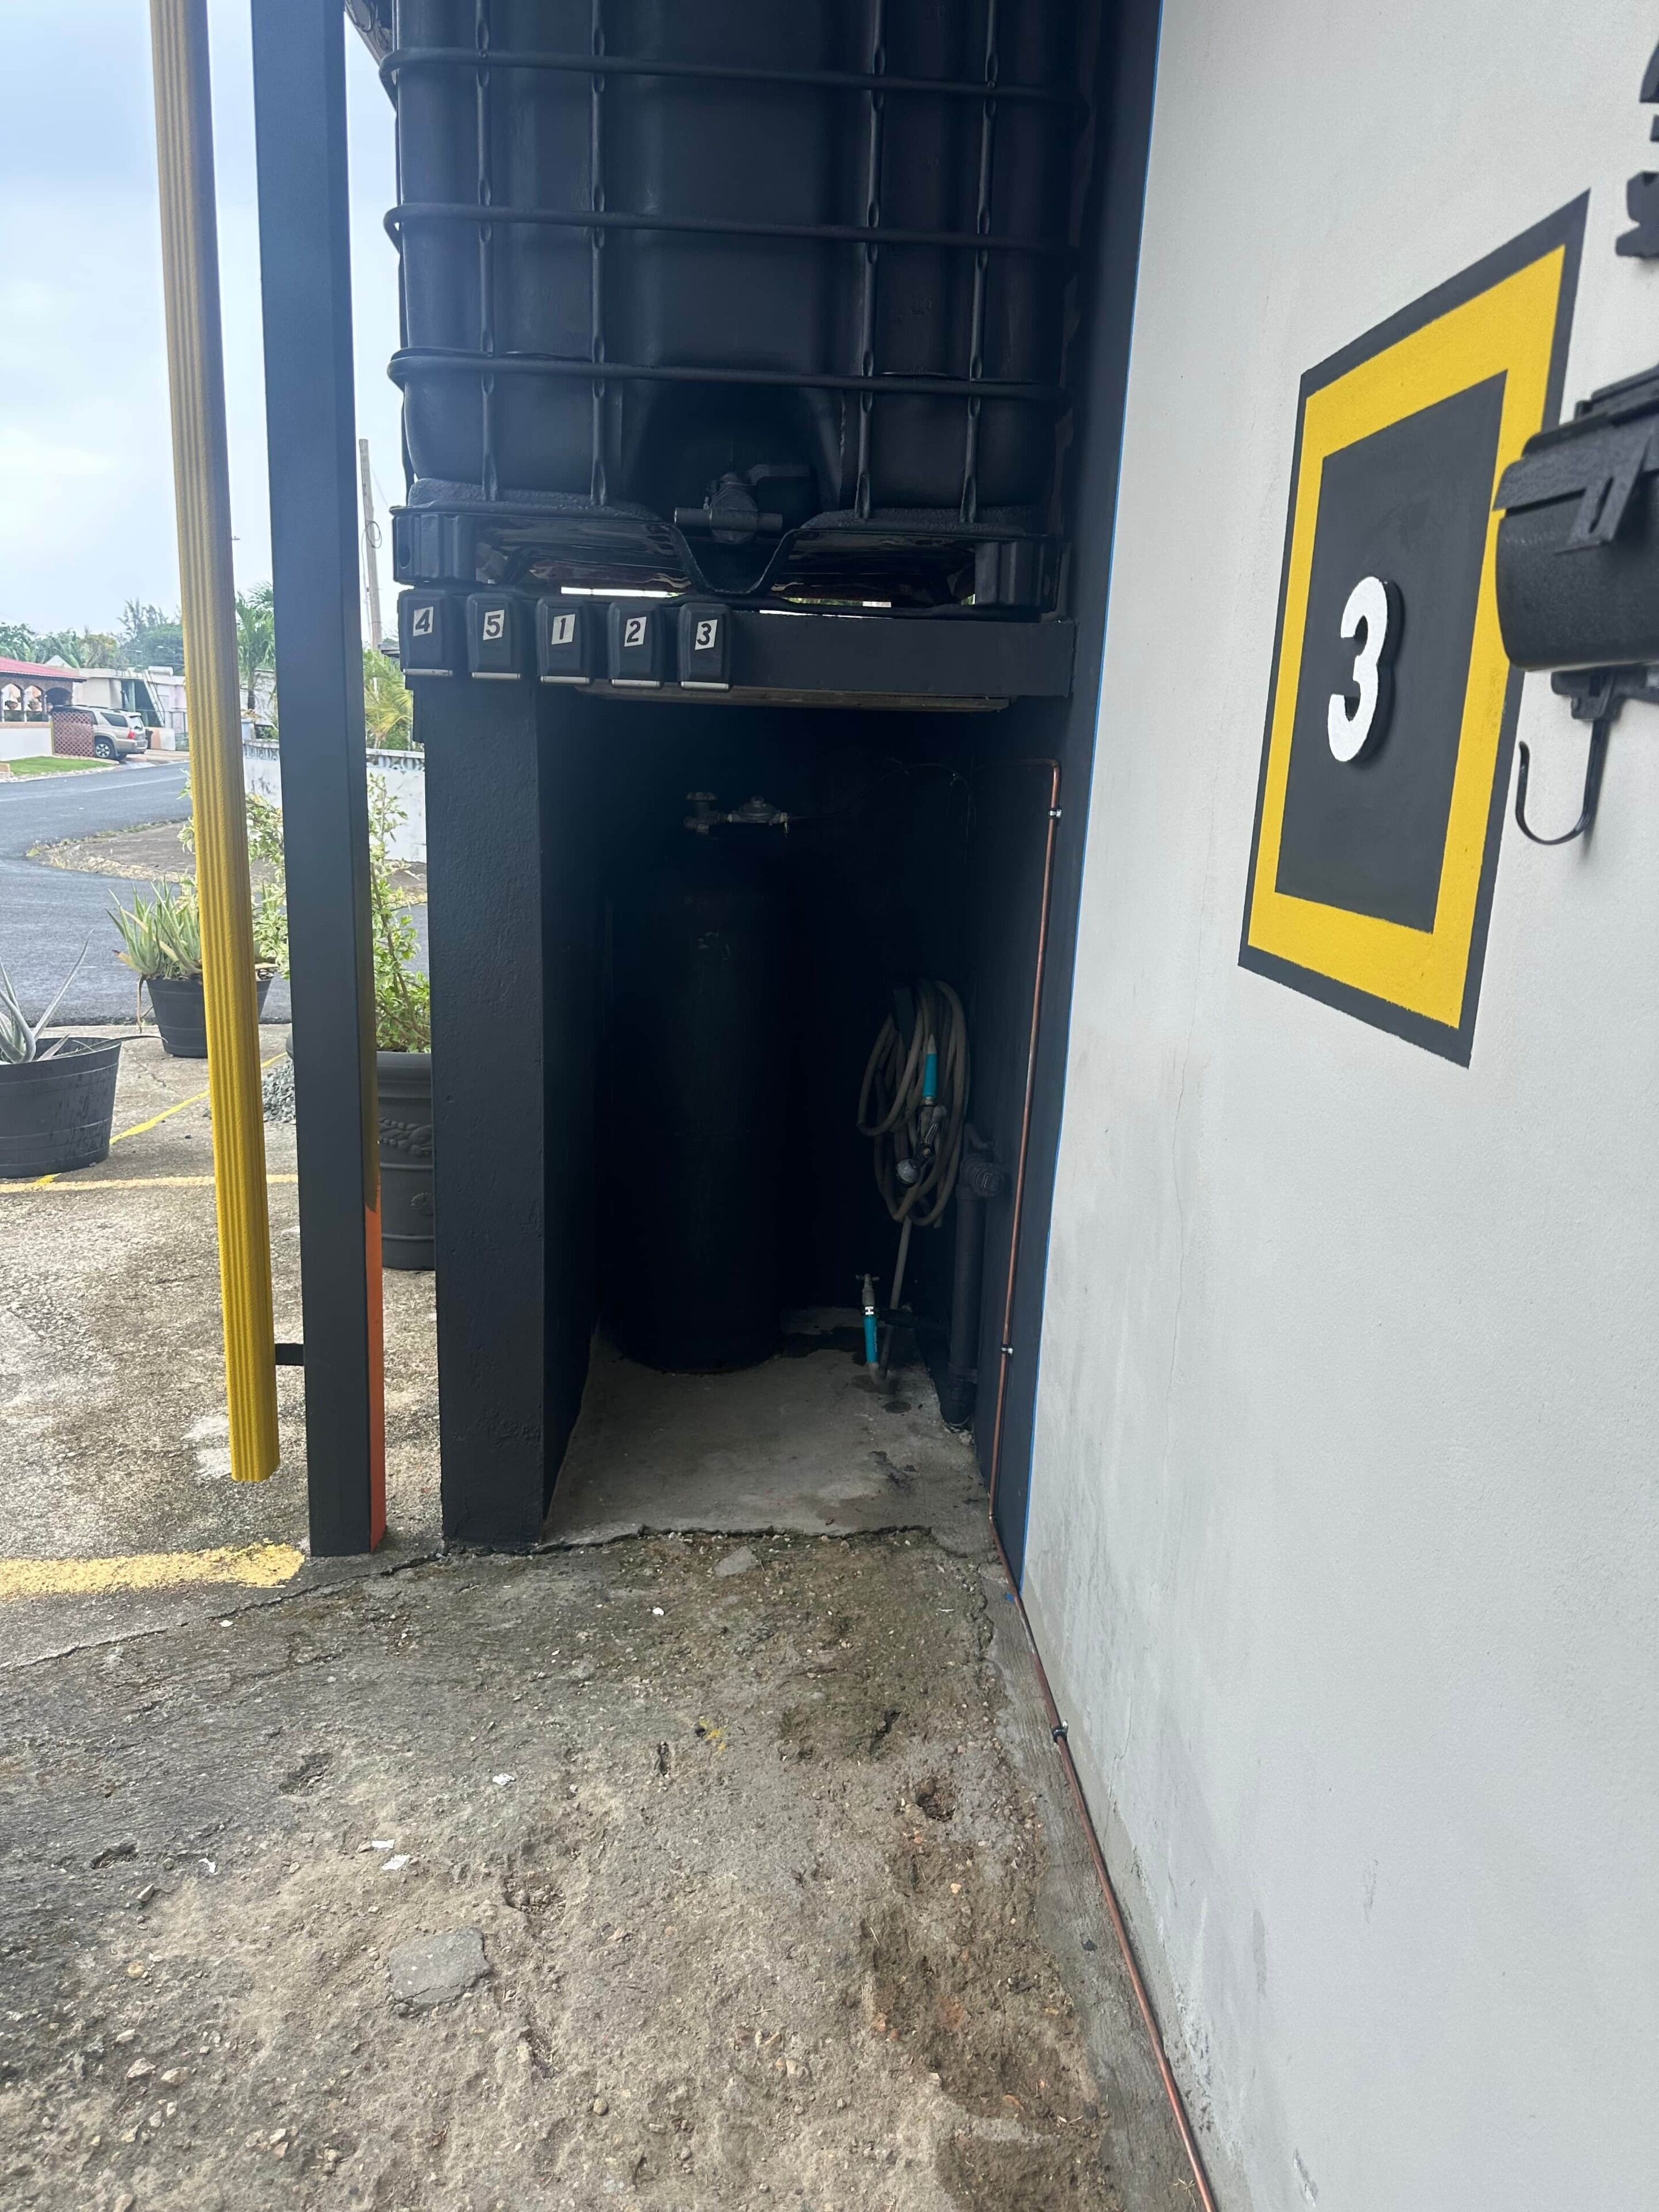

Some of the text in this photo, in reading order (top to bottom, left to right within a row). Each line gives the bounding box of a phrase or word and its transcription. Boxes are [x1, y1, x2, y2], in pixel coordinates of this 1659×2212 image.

[415, 609, 430, 632] 4
[486, 614, 501, 637] 5
[559, 618, 566, 640] 1
[626, 620, 641, 643] 2
[696, 623, 711, 646] 3
[1327, 575, 1388, 762] 3
